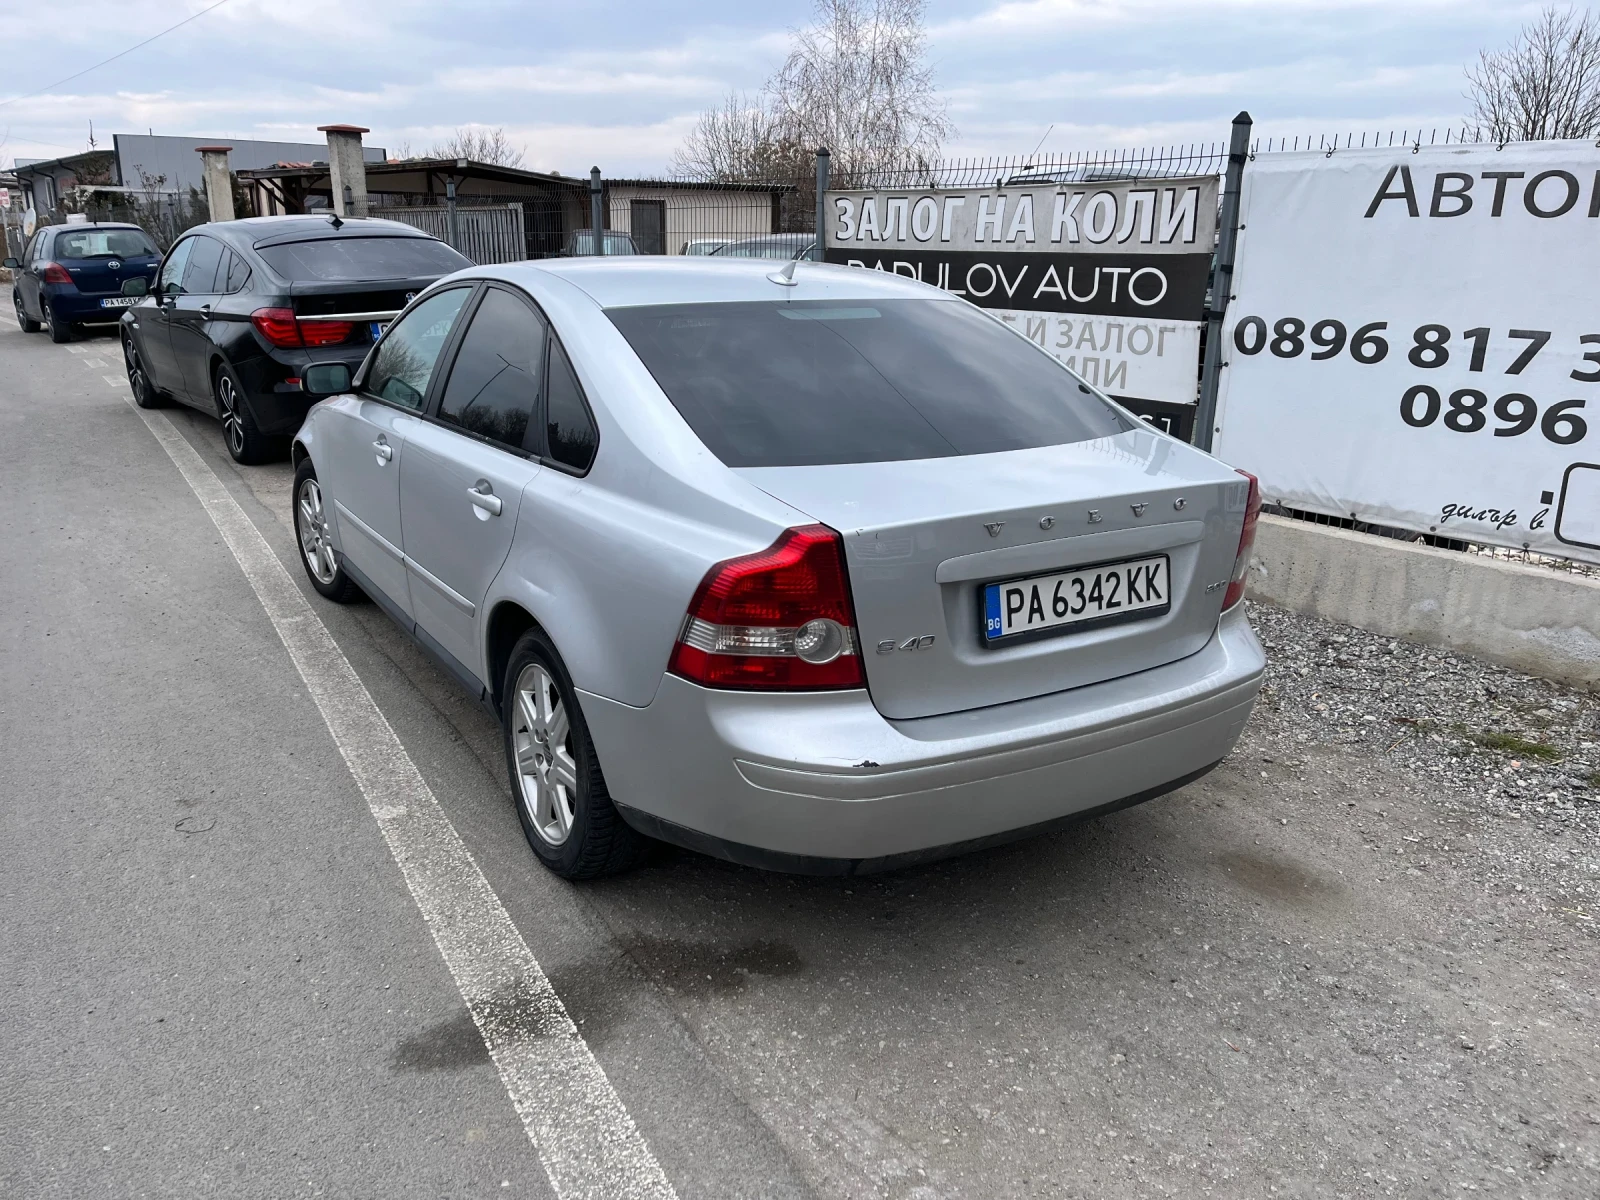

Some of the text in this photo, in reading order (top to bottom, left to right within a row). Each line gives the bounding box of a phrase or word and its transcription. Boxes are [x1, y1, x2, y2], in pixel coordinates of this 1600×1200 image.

[835, 186, 1200, 244] ЗАЛОГ НА КОЛИ
[1364, 165, 1600, 218] АВТО
[1033, 264, 1168, 306] AUTO
[1055, 318, 1176, 357] ЗАЛОГ
[1234, 315, 1389, 365] 0896
[1408, 324, 1552, 375] 817
[1400, 384, 1588, 445] 0896
[983, 497, 1188, 538] VOLVO
[988, 618, 1001, 631] BG
